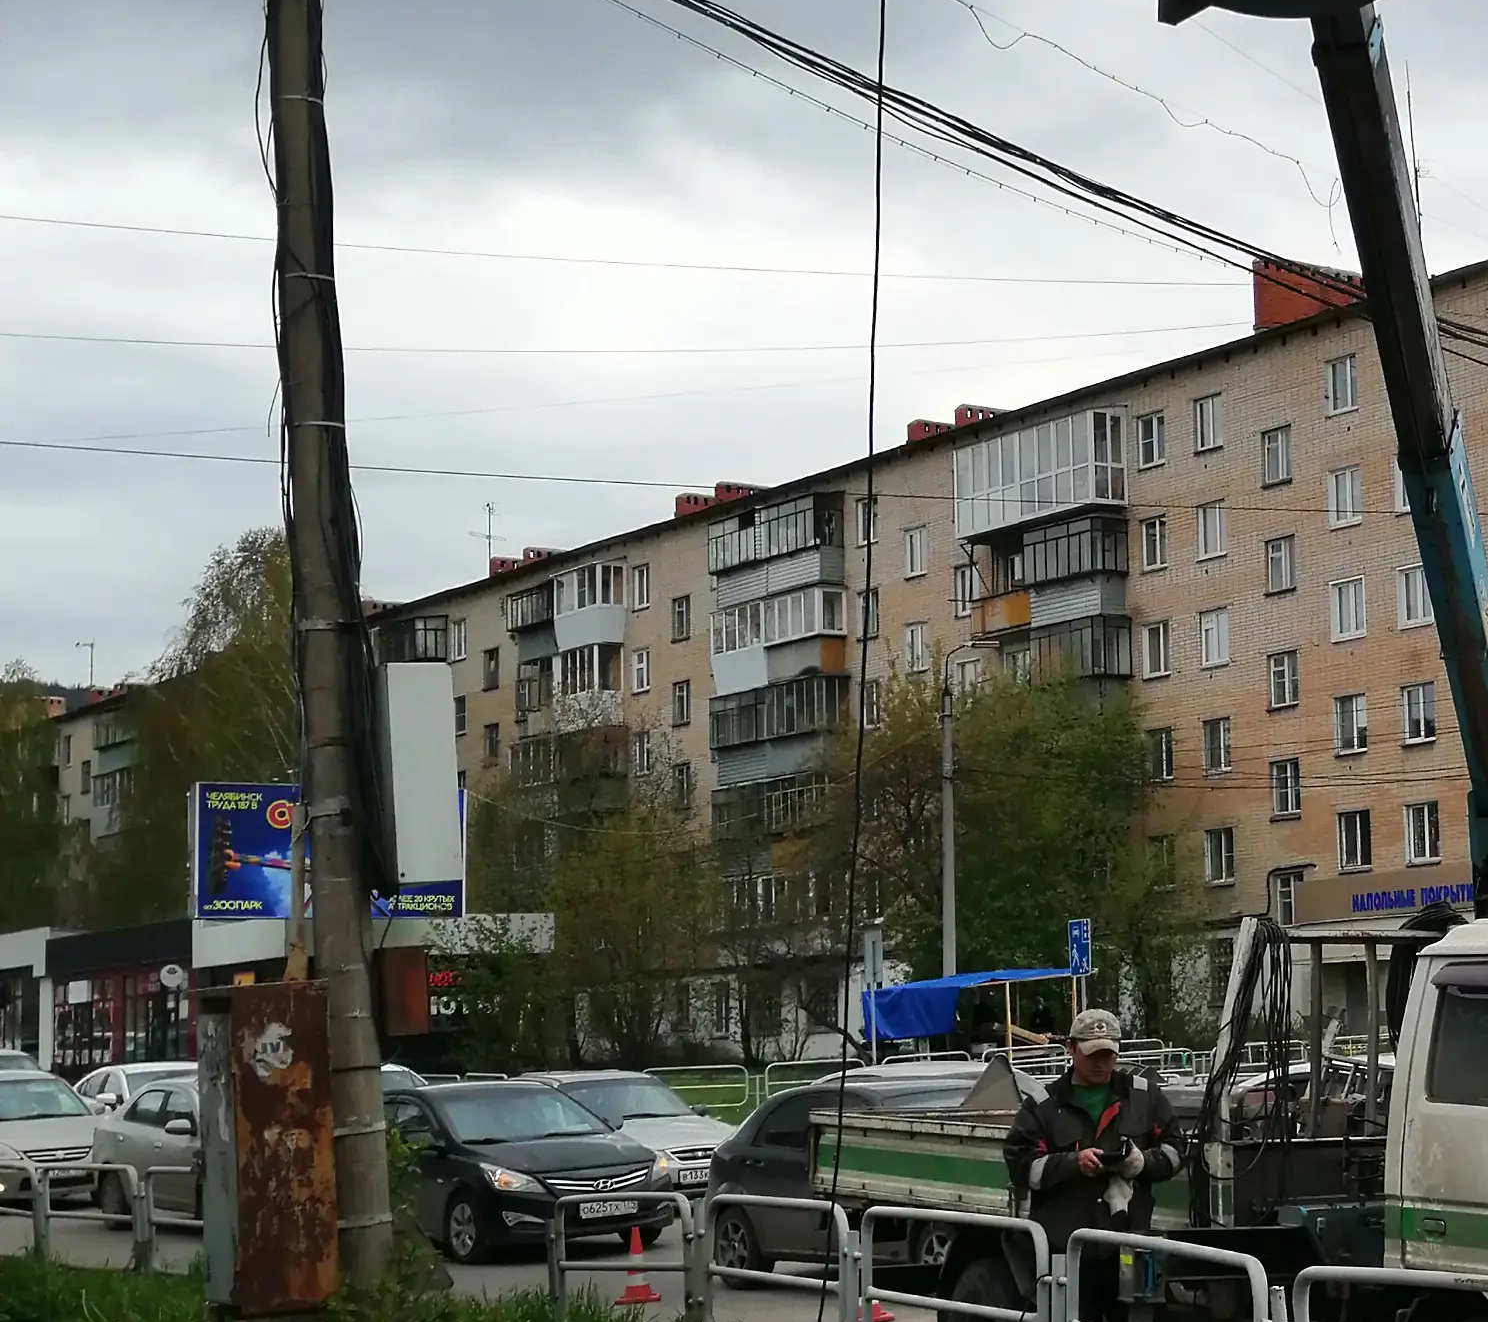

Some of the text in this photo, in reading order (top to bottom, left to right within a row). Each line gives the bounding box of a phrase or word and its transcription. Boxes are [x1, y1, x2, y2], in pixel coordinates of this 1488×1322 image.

[205, 791, 263, 801] ЧЕЛЯБИНСК
[1352, 883, 1473, 912] НАПОЛЬНЫЕ ПОКРЫТИ
[213, 900, 263, 910] ЗООПАРК
[582, 1202, 620, 1215] О625ТХ
